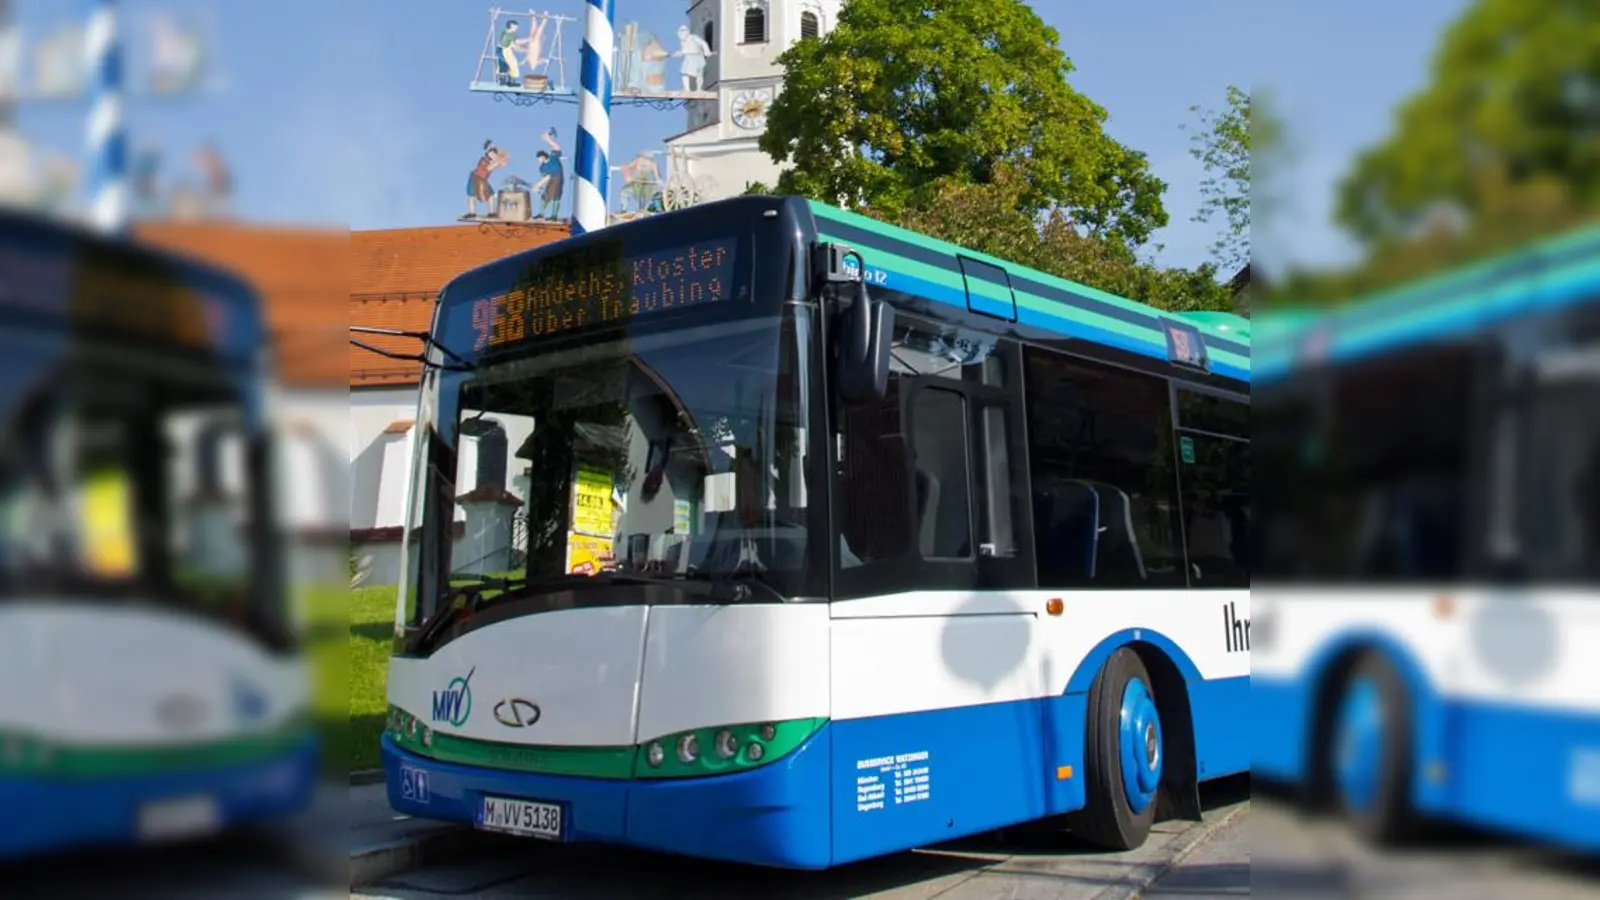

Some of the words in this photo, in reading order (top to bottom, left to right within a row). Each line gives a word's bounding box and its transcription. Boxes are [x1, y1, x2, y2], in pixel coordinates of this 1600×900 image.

[631, 246, 726, 286] Kloster
[601, 279, 722, 320] Traubing
[472, 290, 525, 351] 958
[485, 801, 495, 823] M
[504, 802, 521, 826] VV
[523, 805, 559, 831] 5138
